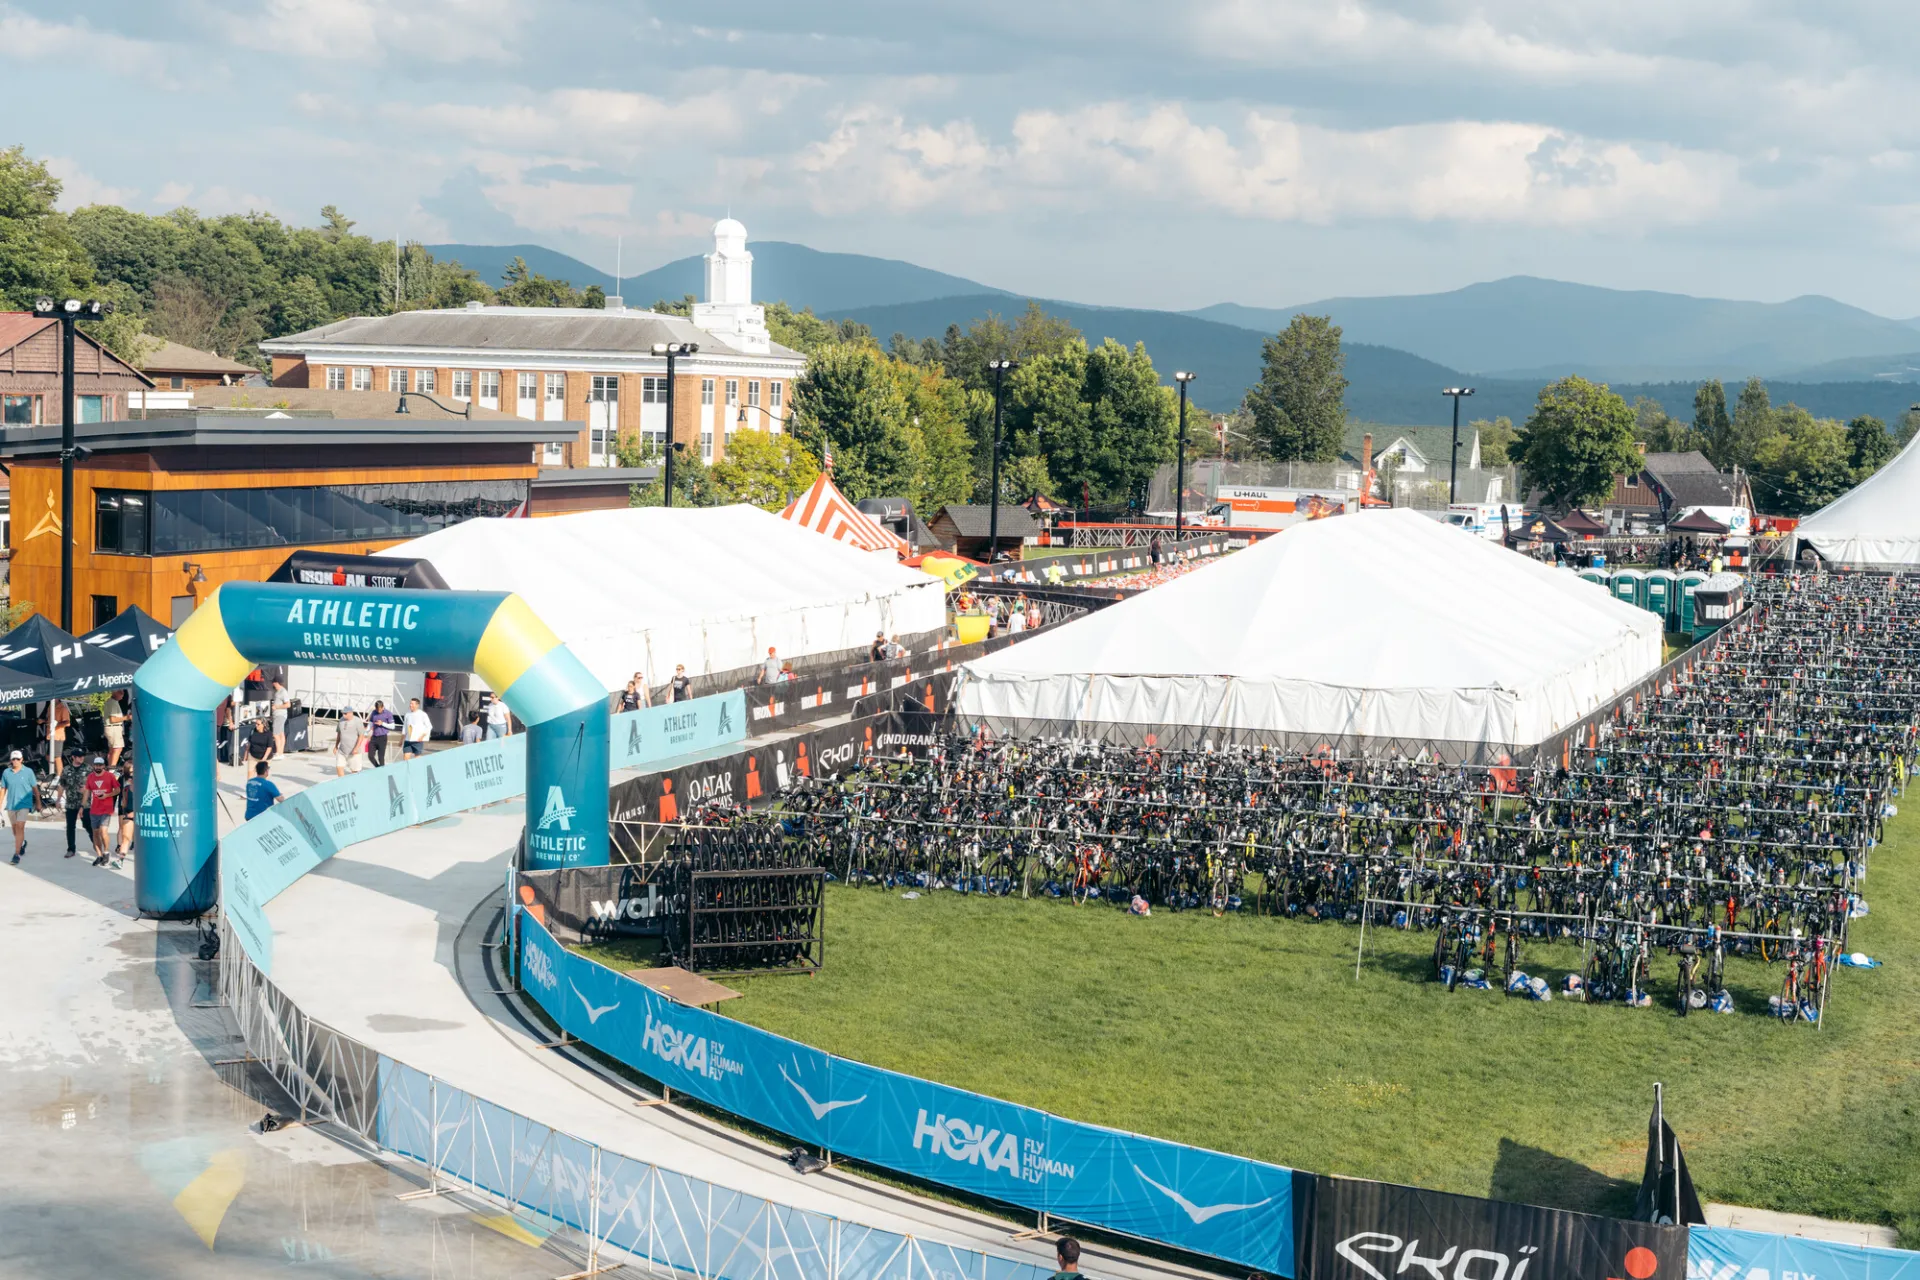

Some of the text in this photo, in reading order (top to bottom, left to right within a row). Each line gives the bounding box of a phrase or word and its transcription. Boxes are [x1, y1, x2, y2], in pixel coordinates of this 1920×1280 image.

[372, 576, 397, 588] STORE
[287, 598, 420, 630] ATHLETIC
[304, 632, 370, 649] BREWING
[294, 650, 417, 665] NON-ALCOHOLIC BREWS
[98, 672, 133, 688] Hyperice
[664, 712, 698, 733] ATHLETIC
[465, 753, 504, 779] ATHLETIC
[690, 772, 732, 801] QATAR
[136, 812, 189, 827] ATHLETIC
[530, 833, 586, 851] ATHLETIC
[642, 1014, 707, 1077] HOKA
[711, 1040, 724, 1055] FLY
[710, 1053, 744, 1076] HUMAN
[708, 1067, 724, 1082] FLY
[913, 1108, 1019, 1179] HOKA
[1024, 1137, 1044, 1155] FLY
[1023, 1152, 1074, 1179] HUMAN
[1022, 1167, 1043, 1184] FLY
